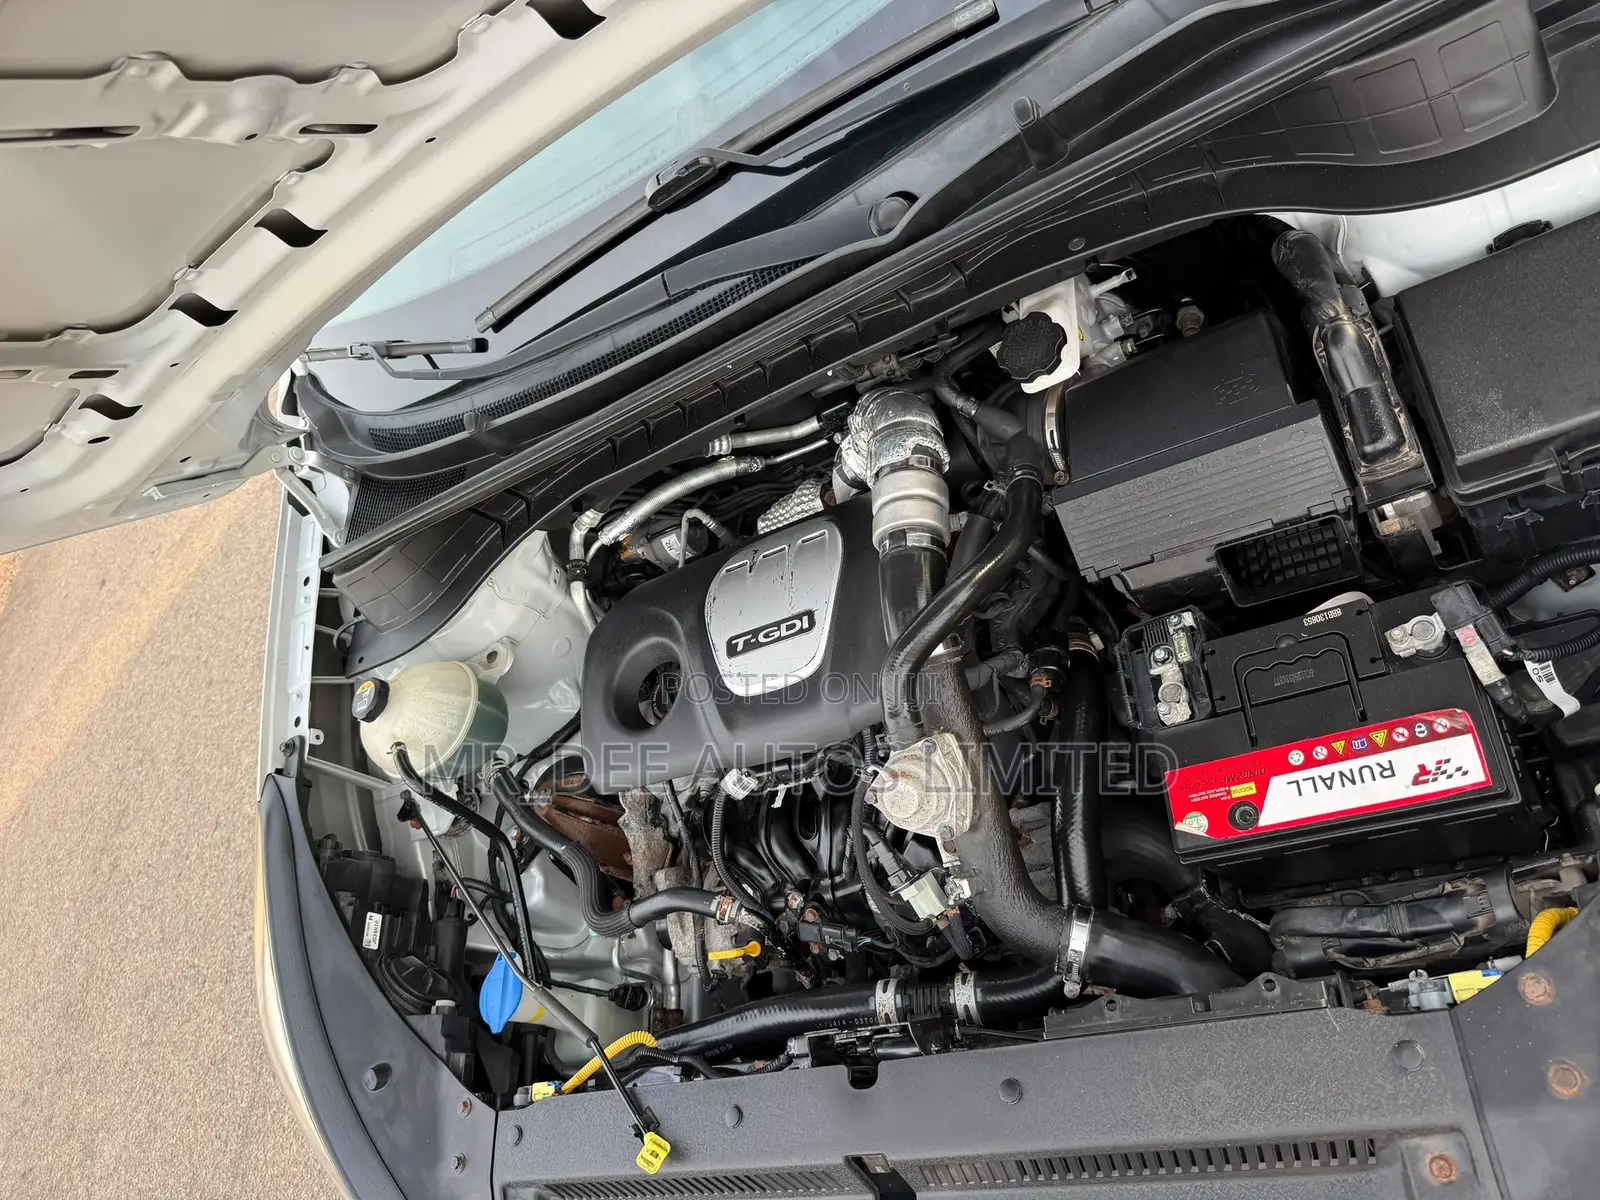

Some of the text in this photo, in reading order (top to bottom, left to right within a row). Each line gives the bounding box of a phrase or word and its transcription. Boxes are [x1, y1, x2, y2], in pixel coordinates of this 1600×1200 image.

[1303, 608, 1342, 626] 8BB130853
[731, 614, 811, 652] T-GDI
[1237, 766, 1267, 779] DIN62
[1286, 760, 1396, 797] RUNALL
